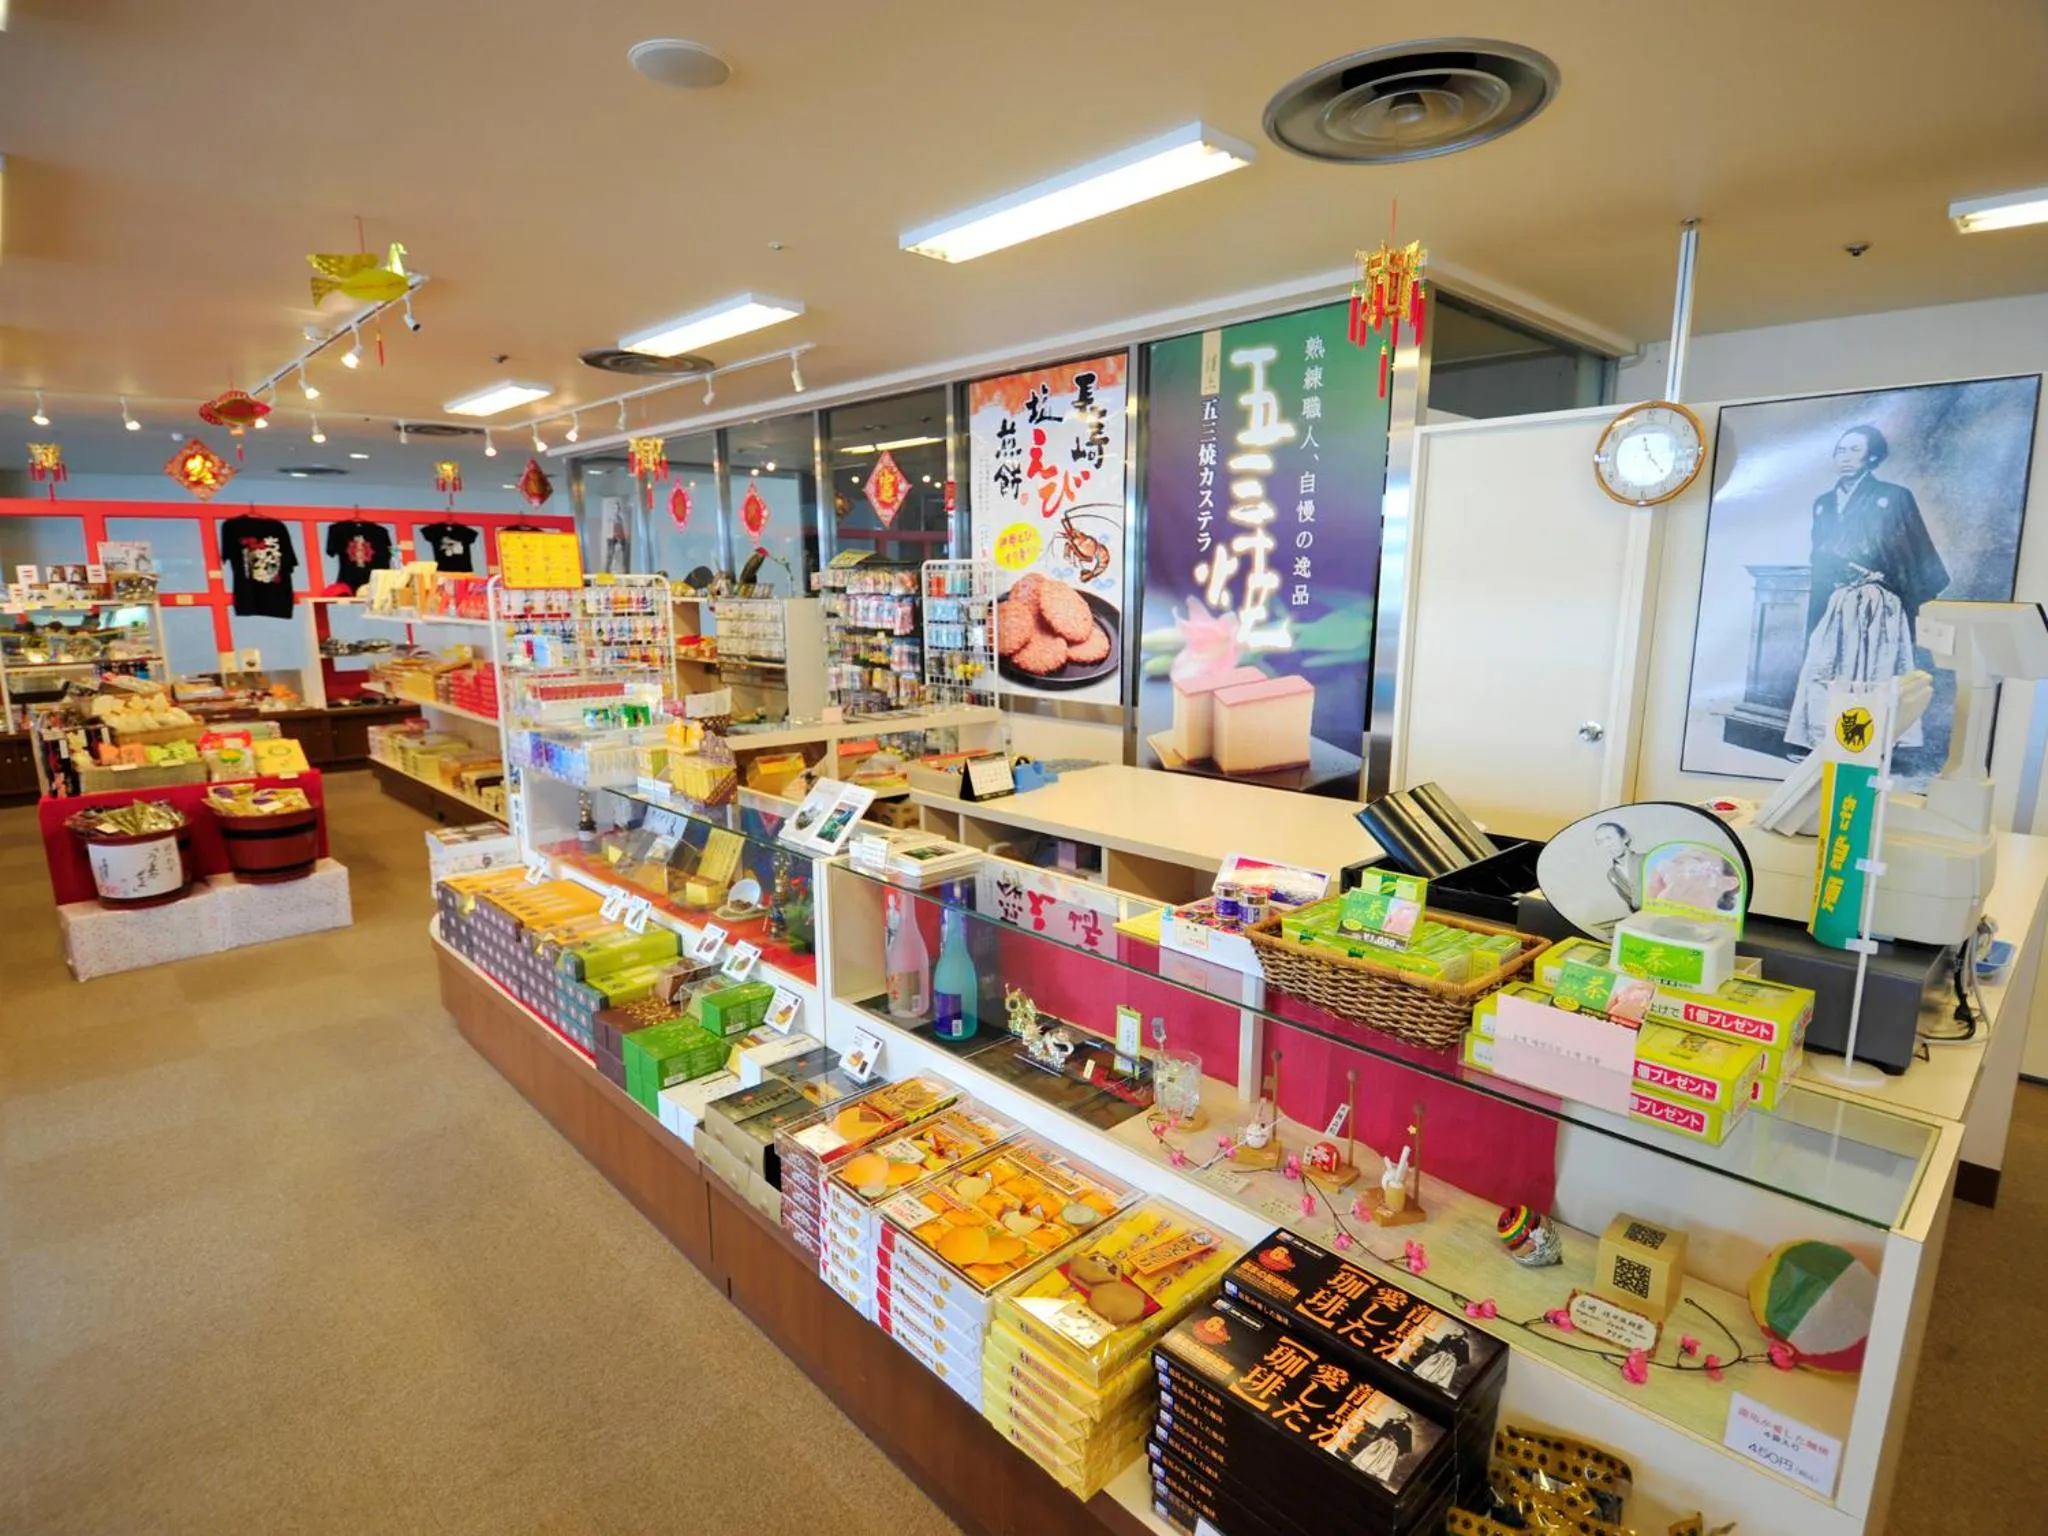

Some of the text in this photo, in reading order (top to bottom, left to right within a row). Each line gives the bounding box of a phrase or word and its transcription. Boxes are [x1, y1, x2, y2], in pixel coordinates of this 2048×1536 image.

[994, 418, 1022, 500] 煎餅
[1070, 373, 1110, 469] 長崎
[1196, 398, 1218, 552] 五三焼カステラ
[1292, 336, 1325, 606] 熟練職人、自慢の逸品
[1687, 1004, 1774, 1040] 1個プレゼント
